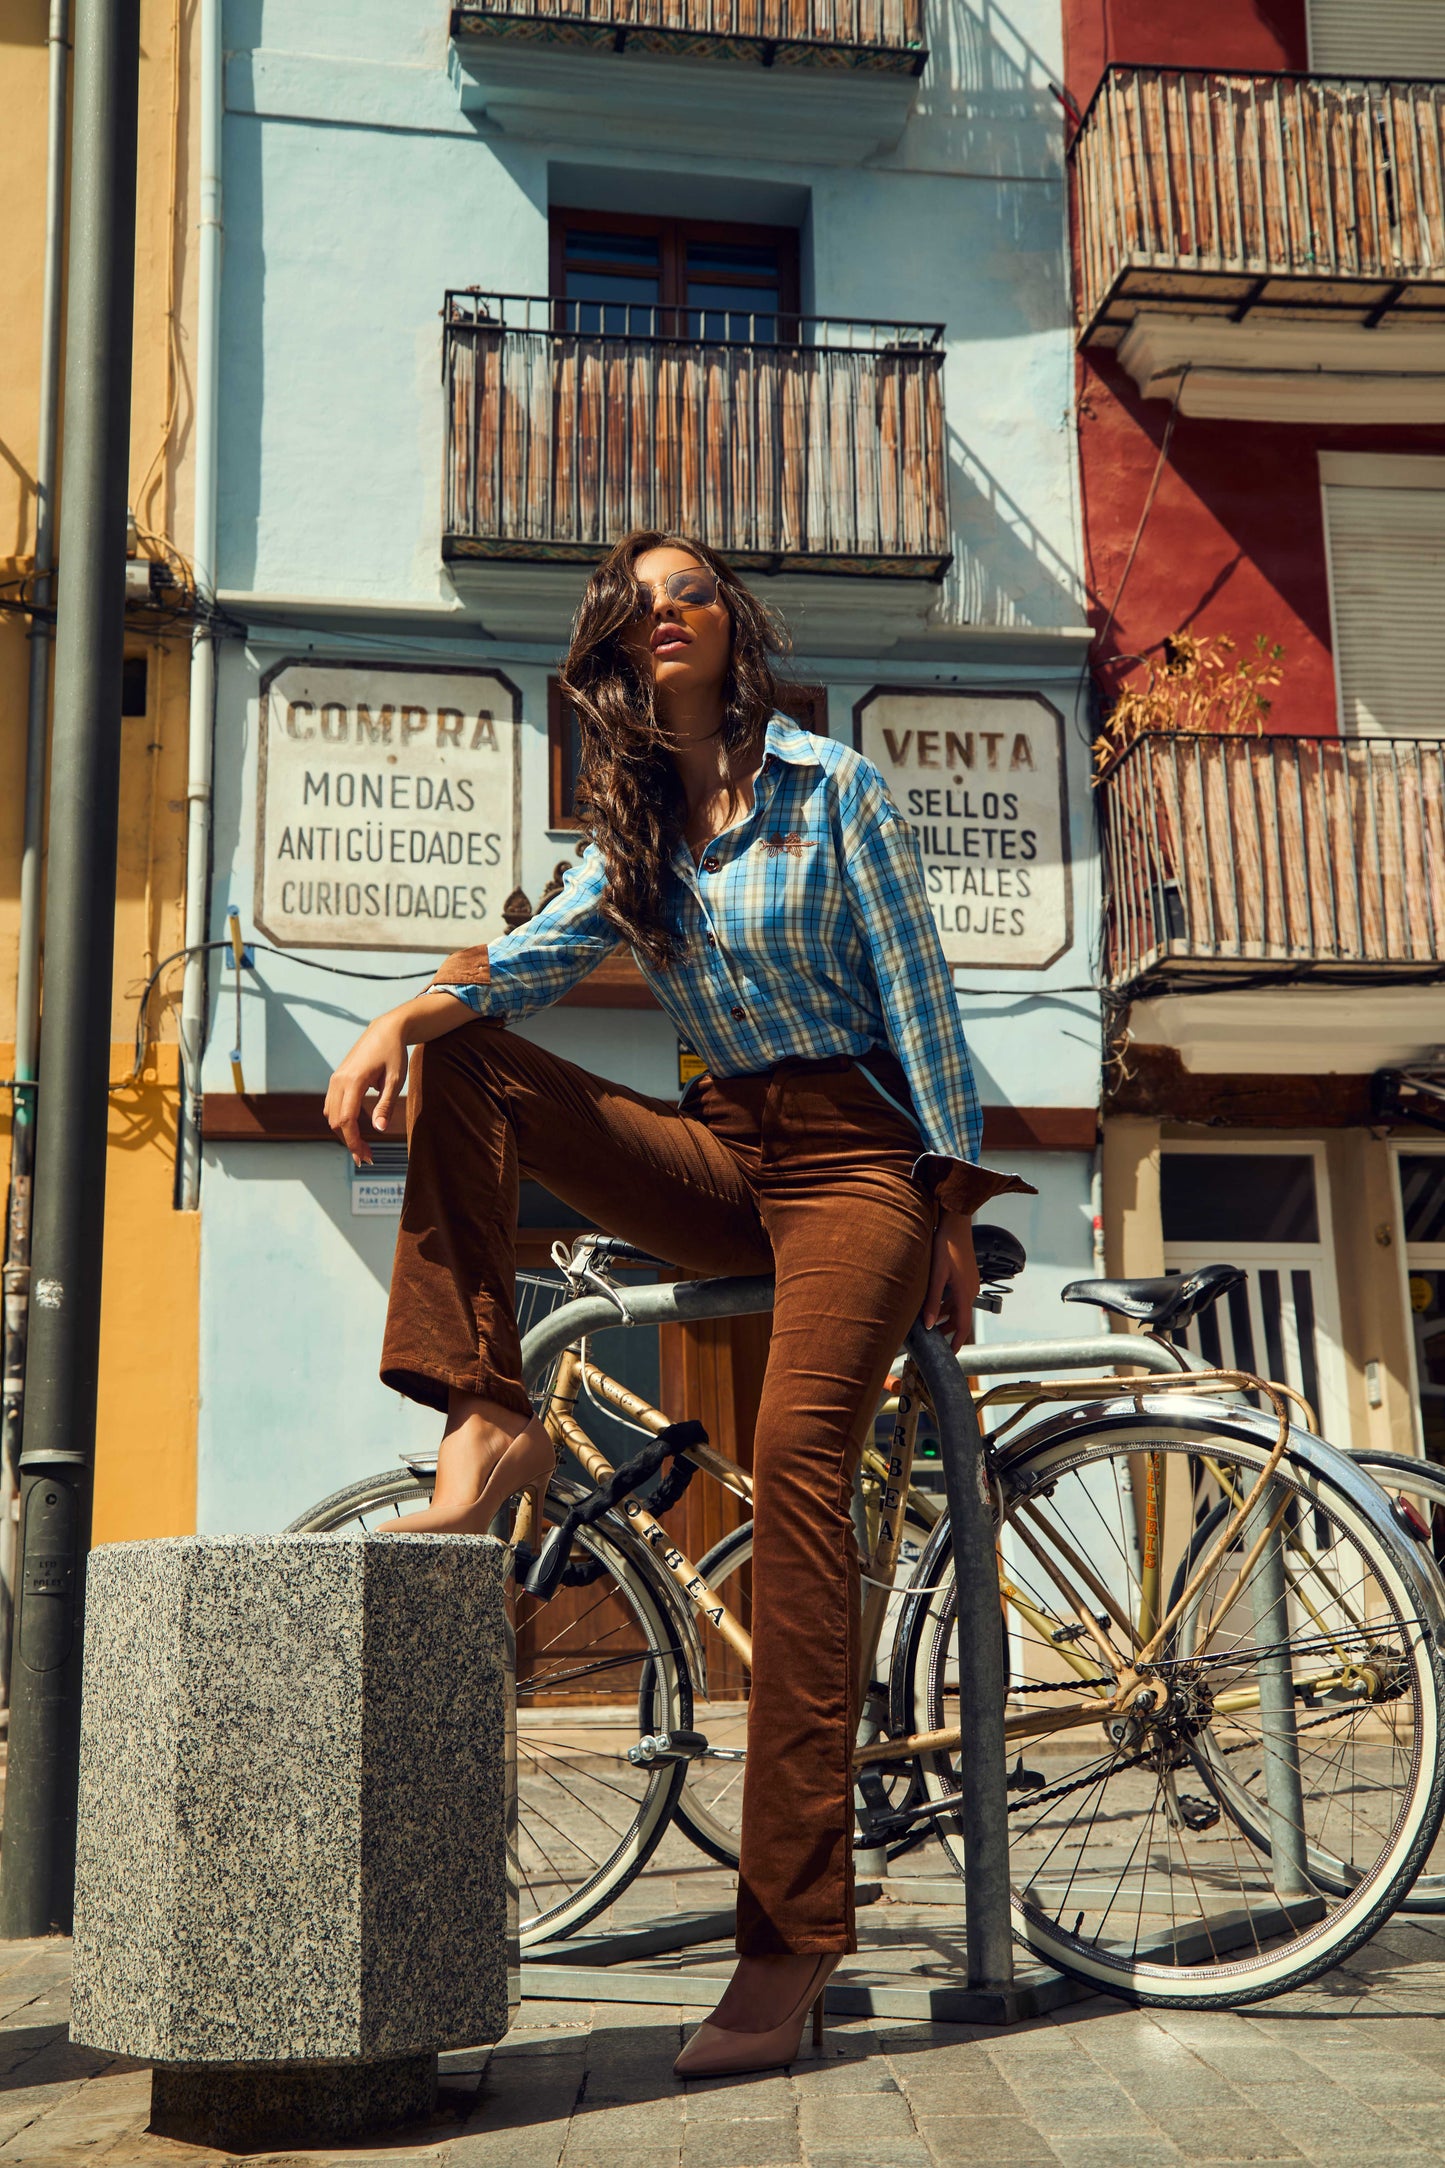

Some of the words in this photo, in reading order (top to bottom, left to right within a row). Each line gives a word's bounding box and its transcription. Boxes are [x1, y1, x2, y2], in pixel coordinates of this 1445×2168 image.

[286, 700, 500, 751] COMPRA
[882, 728, 1037, 771] VENTA
[303, 771, 475, 812] MONEDAS
[908, 789, 1018, 820] SELLOS
[277, 821, 501, 866] ANTIGÜEDADES
[281, 880, 487, 920] CURIOSIDADES
[928, 865, 1031, 898] STALES
[931, 904, 1025, 936] LOJES
[879, 1395, 912, 1542] ORBEA
[624, 1499, 725, 1628] ORBEA
